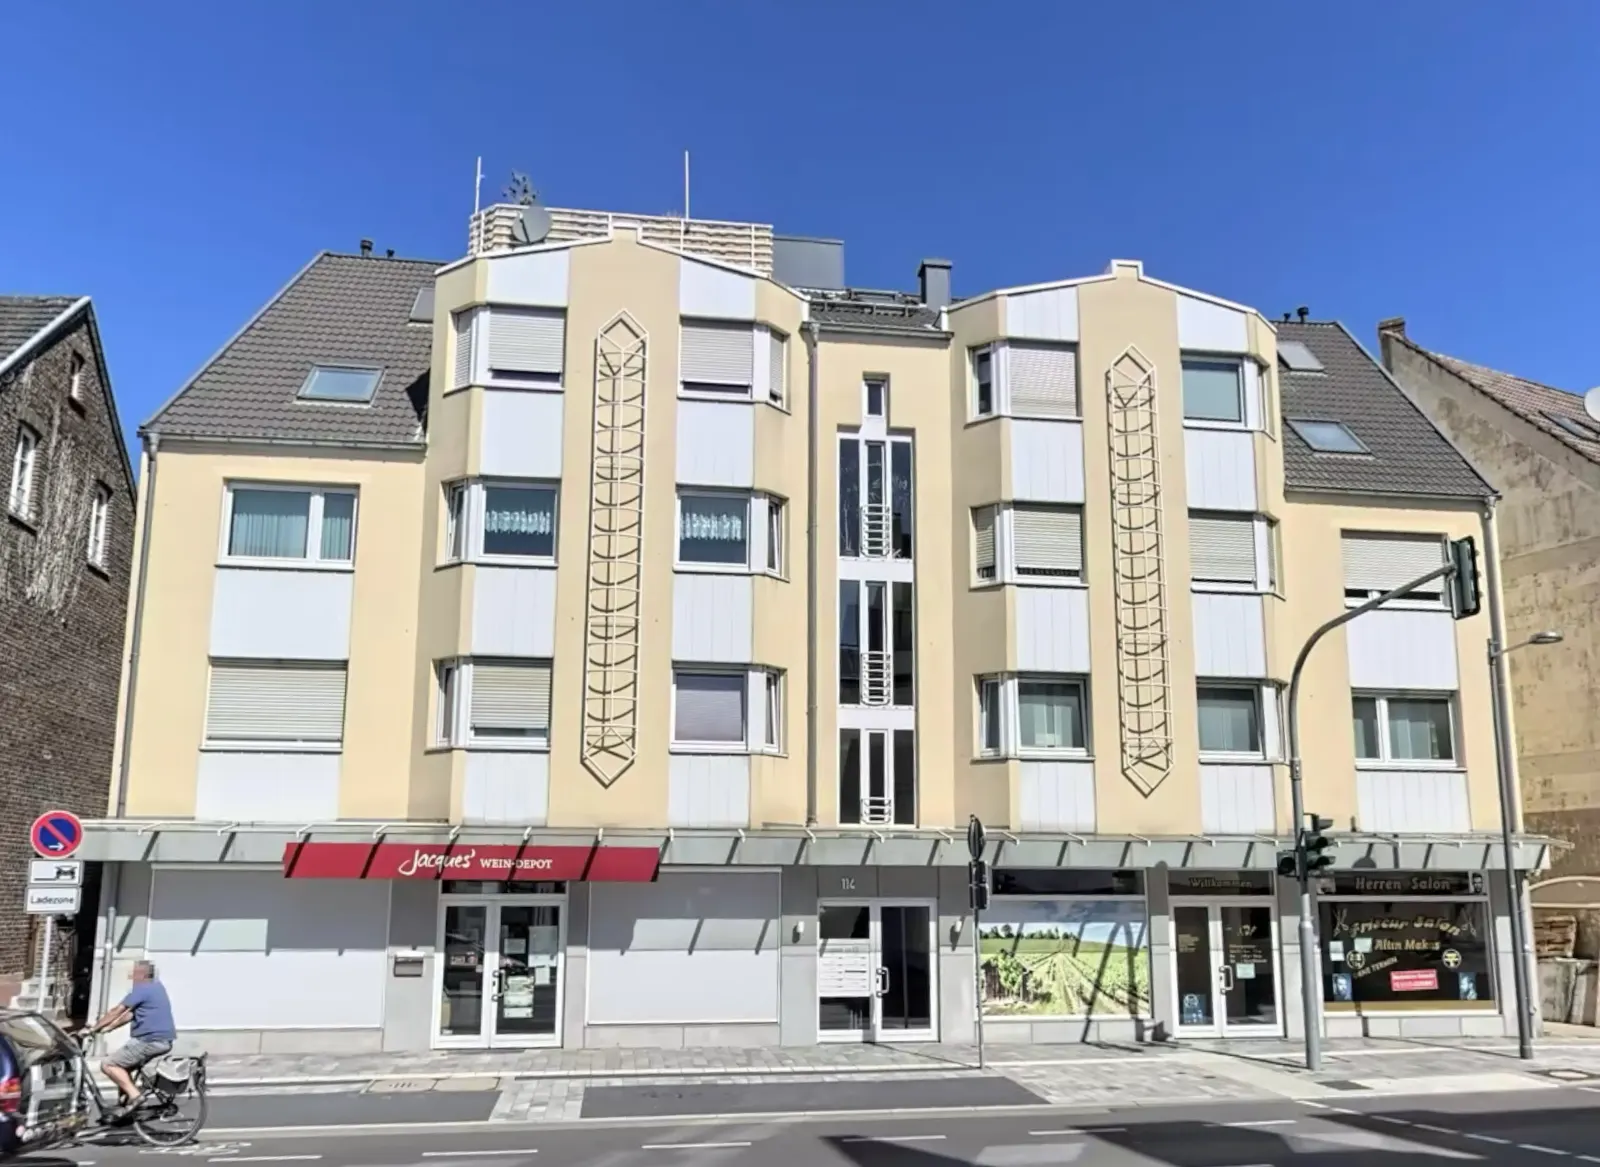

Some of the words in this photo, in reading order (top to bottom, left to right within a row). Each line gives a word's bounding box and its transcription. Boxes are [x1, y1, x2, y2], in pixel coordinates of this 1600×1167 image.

[398, 849, 476, 876] Jacques'
[480, 858, 553, 869] WEIN-DEPOT
[1355, 877, 1402, 890] Herren
[1411, 876, 1451, 890] Salon
[30, 894, 75, 905] Ladezone
